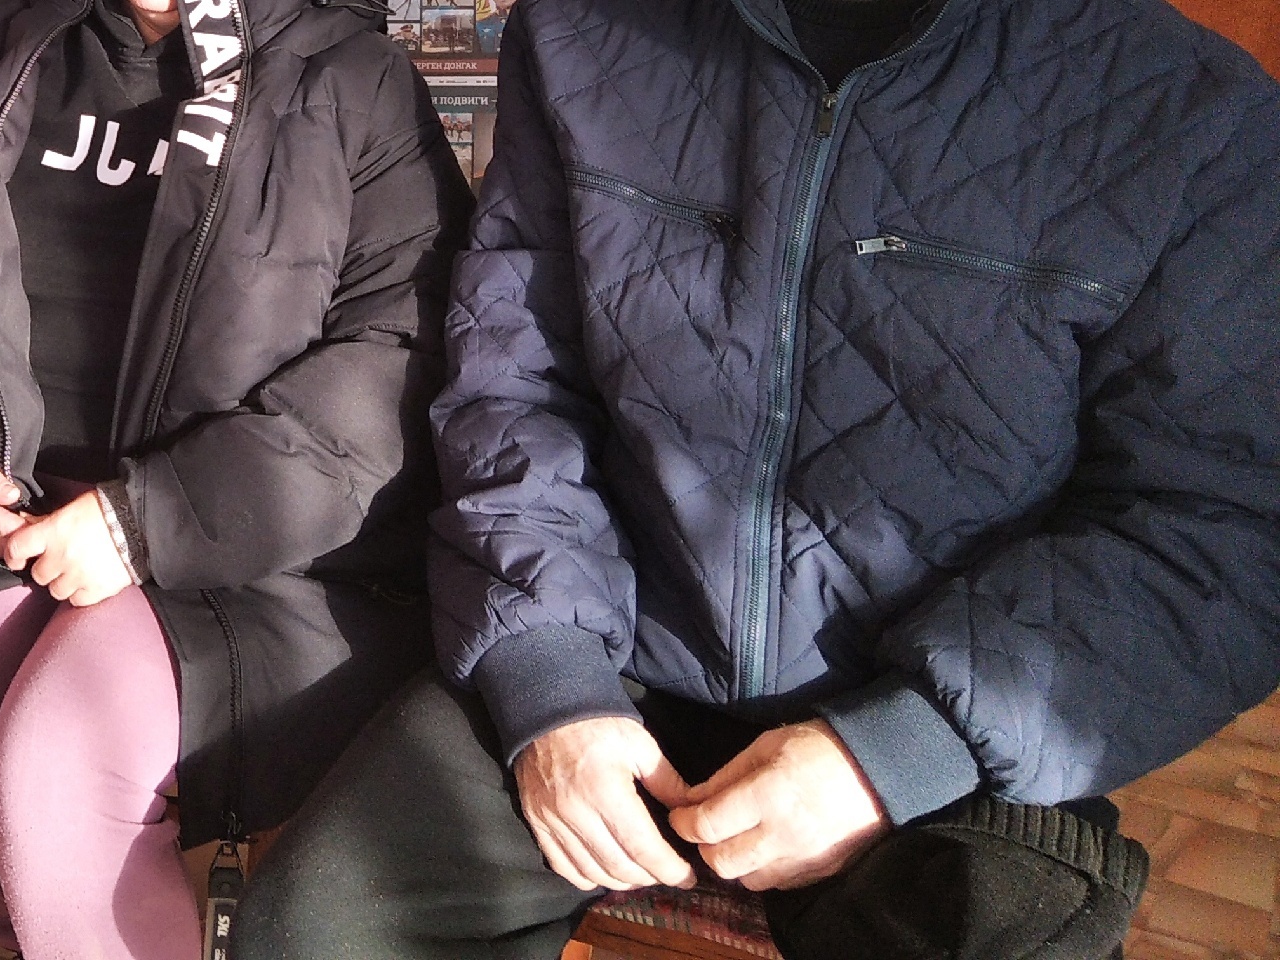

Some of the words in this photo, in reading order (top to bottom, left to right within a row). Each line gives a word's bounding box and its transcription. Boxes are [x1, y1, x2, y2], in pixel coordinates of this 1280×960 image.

[414, 62, 442, 70] ЕРГЕН
[443, 62, 477, 70] ДОНГАК
[439, 96, 489, 106] ПОДВИГИ
[40, 114, 170, 187] JU
